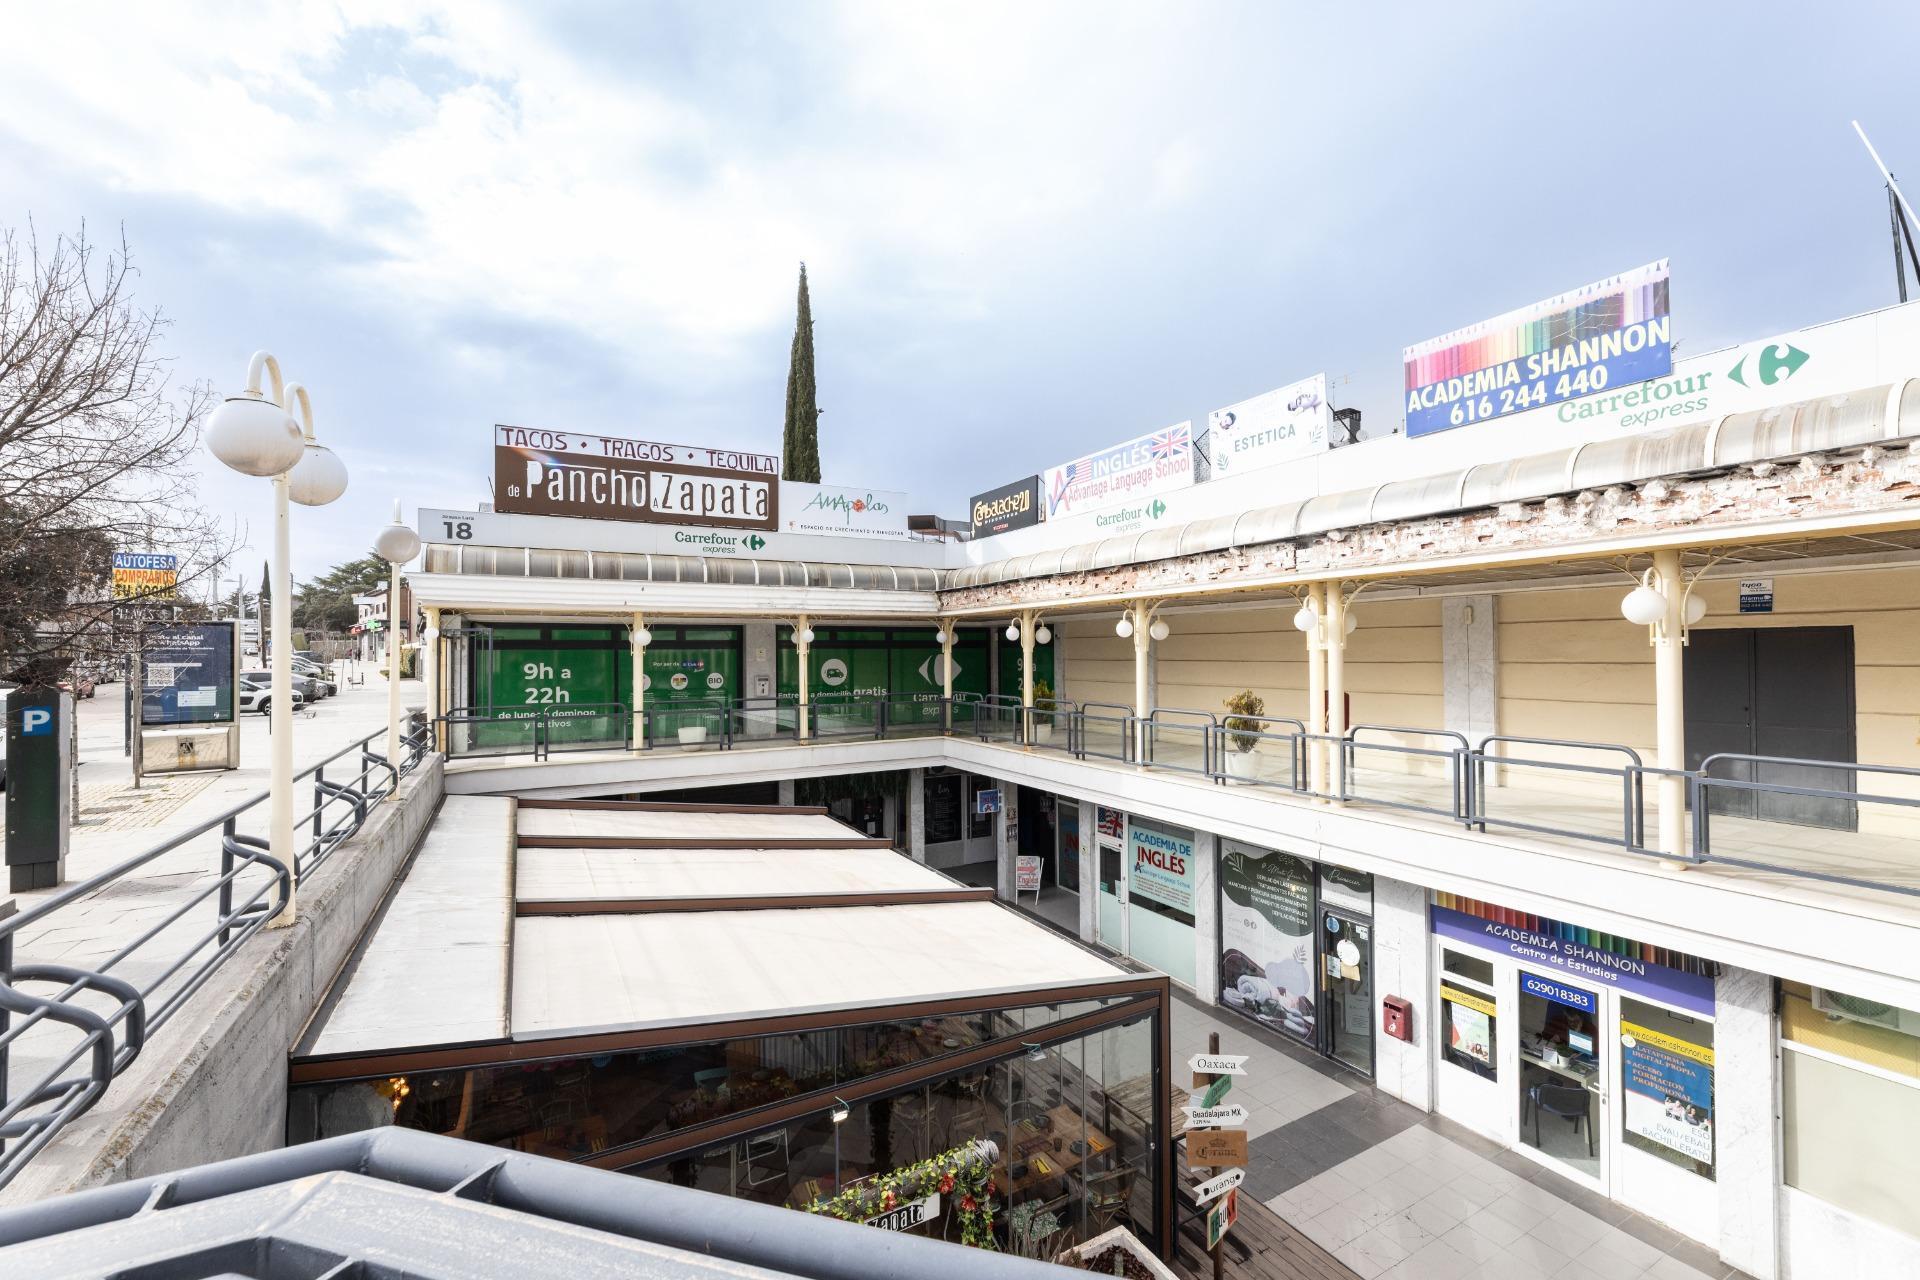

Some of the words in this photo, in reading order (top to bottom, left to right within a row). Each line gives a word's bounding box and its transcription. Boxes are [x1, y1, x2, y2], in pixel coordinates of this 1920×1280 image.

[1408, 362, 1520, 414] ACADEMIA
[1528, 316, 1670, 380] SHANNON
[1450, 399, 1493, 426] 616
[1501, 385, 1548, 414] 244
[1558, 364, 1609, 399] 440
[1556, 369, 1713, 425] Carrefour
[1619, 394, 1709, 429] express
[500, 427, 568, 451] TACOS
[599, 438, 675, 462] TRAGOS
[705, 450, 774, 473] TEQUILA
[1234, 423, 1296, 453] ESTETICA
[1093, 444, 1152, 478] INGLÉS
[1068, 480, 1109, 502] Advantage
[1110, 467, 1153, 492] Language
[1155, 450, 1190, 480] School
[507, 483, 520, 498] de
[526, 460, 647, 508] Pancho
[661, 474, 768, 518] Zapata
[1096, 508, 1143, 528] Carrefour
[1115, 521, 1142, 533] express
[443, 521, 473, 540] 18
[674, 531, 738, 546] Carrefour
[115, 554, 175, 569] AUTOFESA
[702, 546, 736, 554] express
[523, 662, 554, 680] 9h
[561, 668, 571, 679] a
[524, 686, 570, 704] 22h
[23, 710, 51, 732] P
[498, 711, 512, 719] de
[524, 721, 531, 730] y
[1133, 831, 1178, 852] ACADEMIA
[1179, 843, 1192, 856] DE
[1137, 845, 1186, 876] INGLÉS
[1485, 924, 1559, 952] ACADEMIA
[1564, 944, 1646, 976] SHANNON
[1510, 943, 1548, 962] Centro
[1550, 954, 1564, 965] de
[1567, 957, 1618, 981] Estudios
[1527, 980, 1589, 1007] 629018383
[1197, 1057, 1236, 1070] Oaxaca
[1192, 1109, 1230, 1119] Guadalajara
[1231, 1108, 1242, 1117] MX
[1642, 1126, 1710, 1162] BACHILLERATO
[1691, 1127, 1711, 1140] ESO
[1203, 1173, 1241, 1197] Durango
